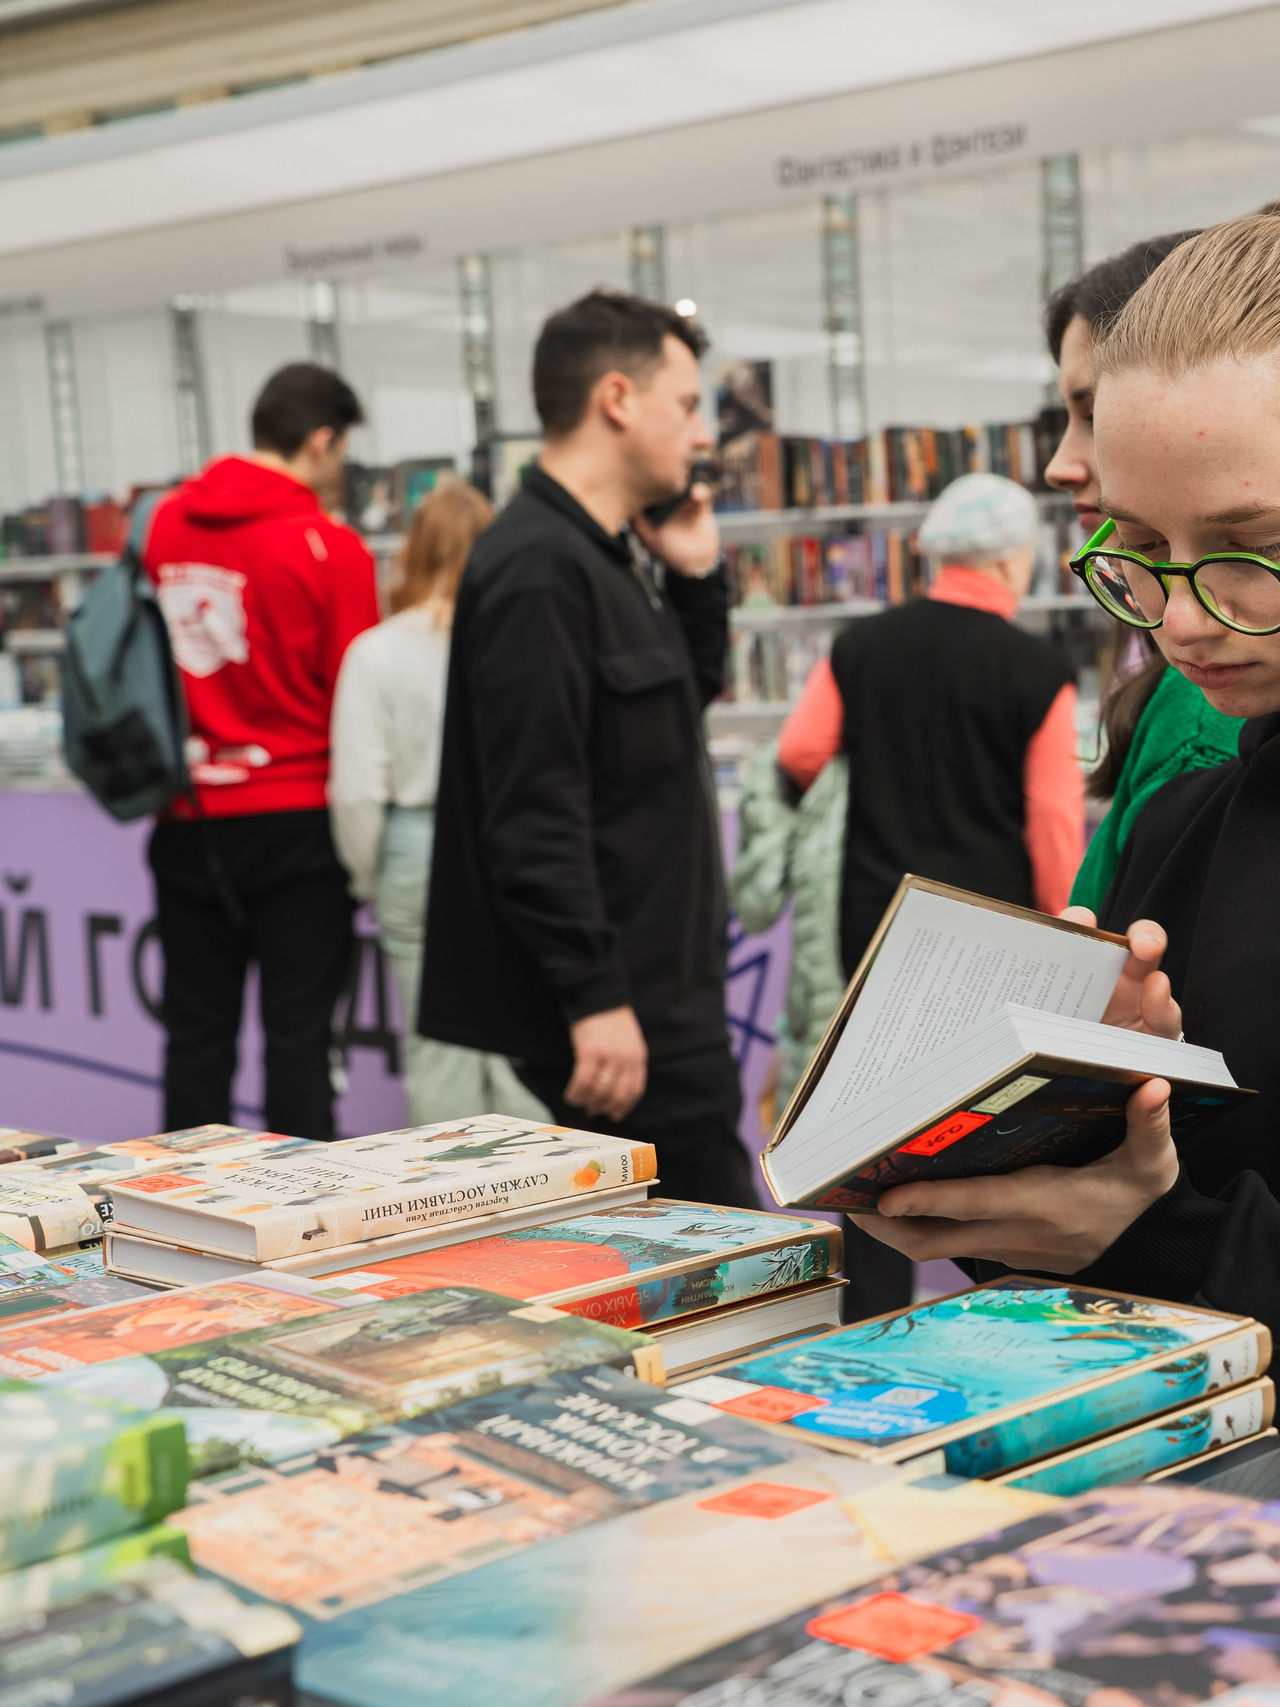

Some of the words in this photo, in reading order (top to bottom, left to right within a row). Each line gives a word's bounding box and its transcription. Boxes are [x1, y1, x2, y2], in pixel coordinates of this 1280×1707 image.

[490, 1173, 549, 1195] СЛУЖБА
[407, 1183, 486, 1212] ДОСТАВКИ
[474, 1195, 510, 1209] Карстен
[361, 1202, 404, 1222] КНИГ
[428, 1202, 474, 1219] Себастиан
[604, 1289, 650, 1313] БЕЛЫХ
